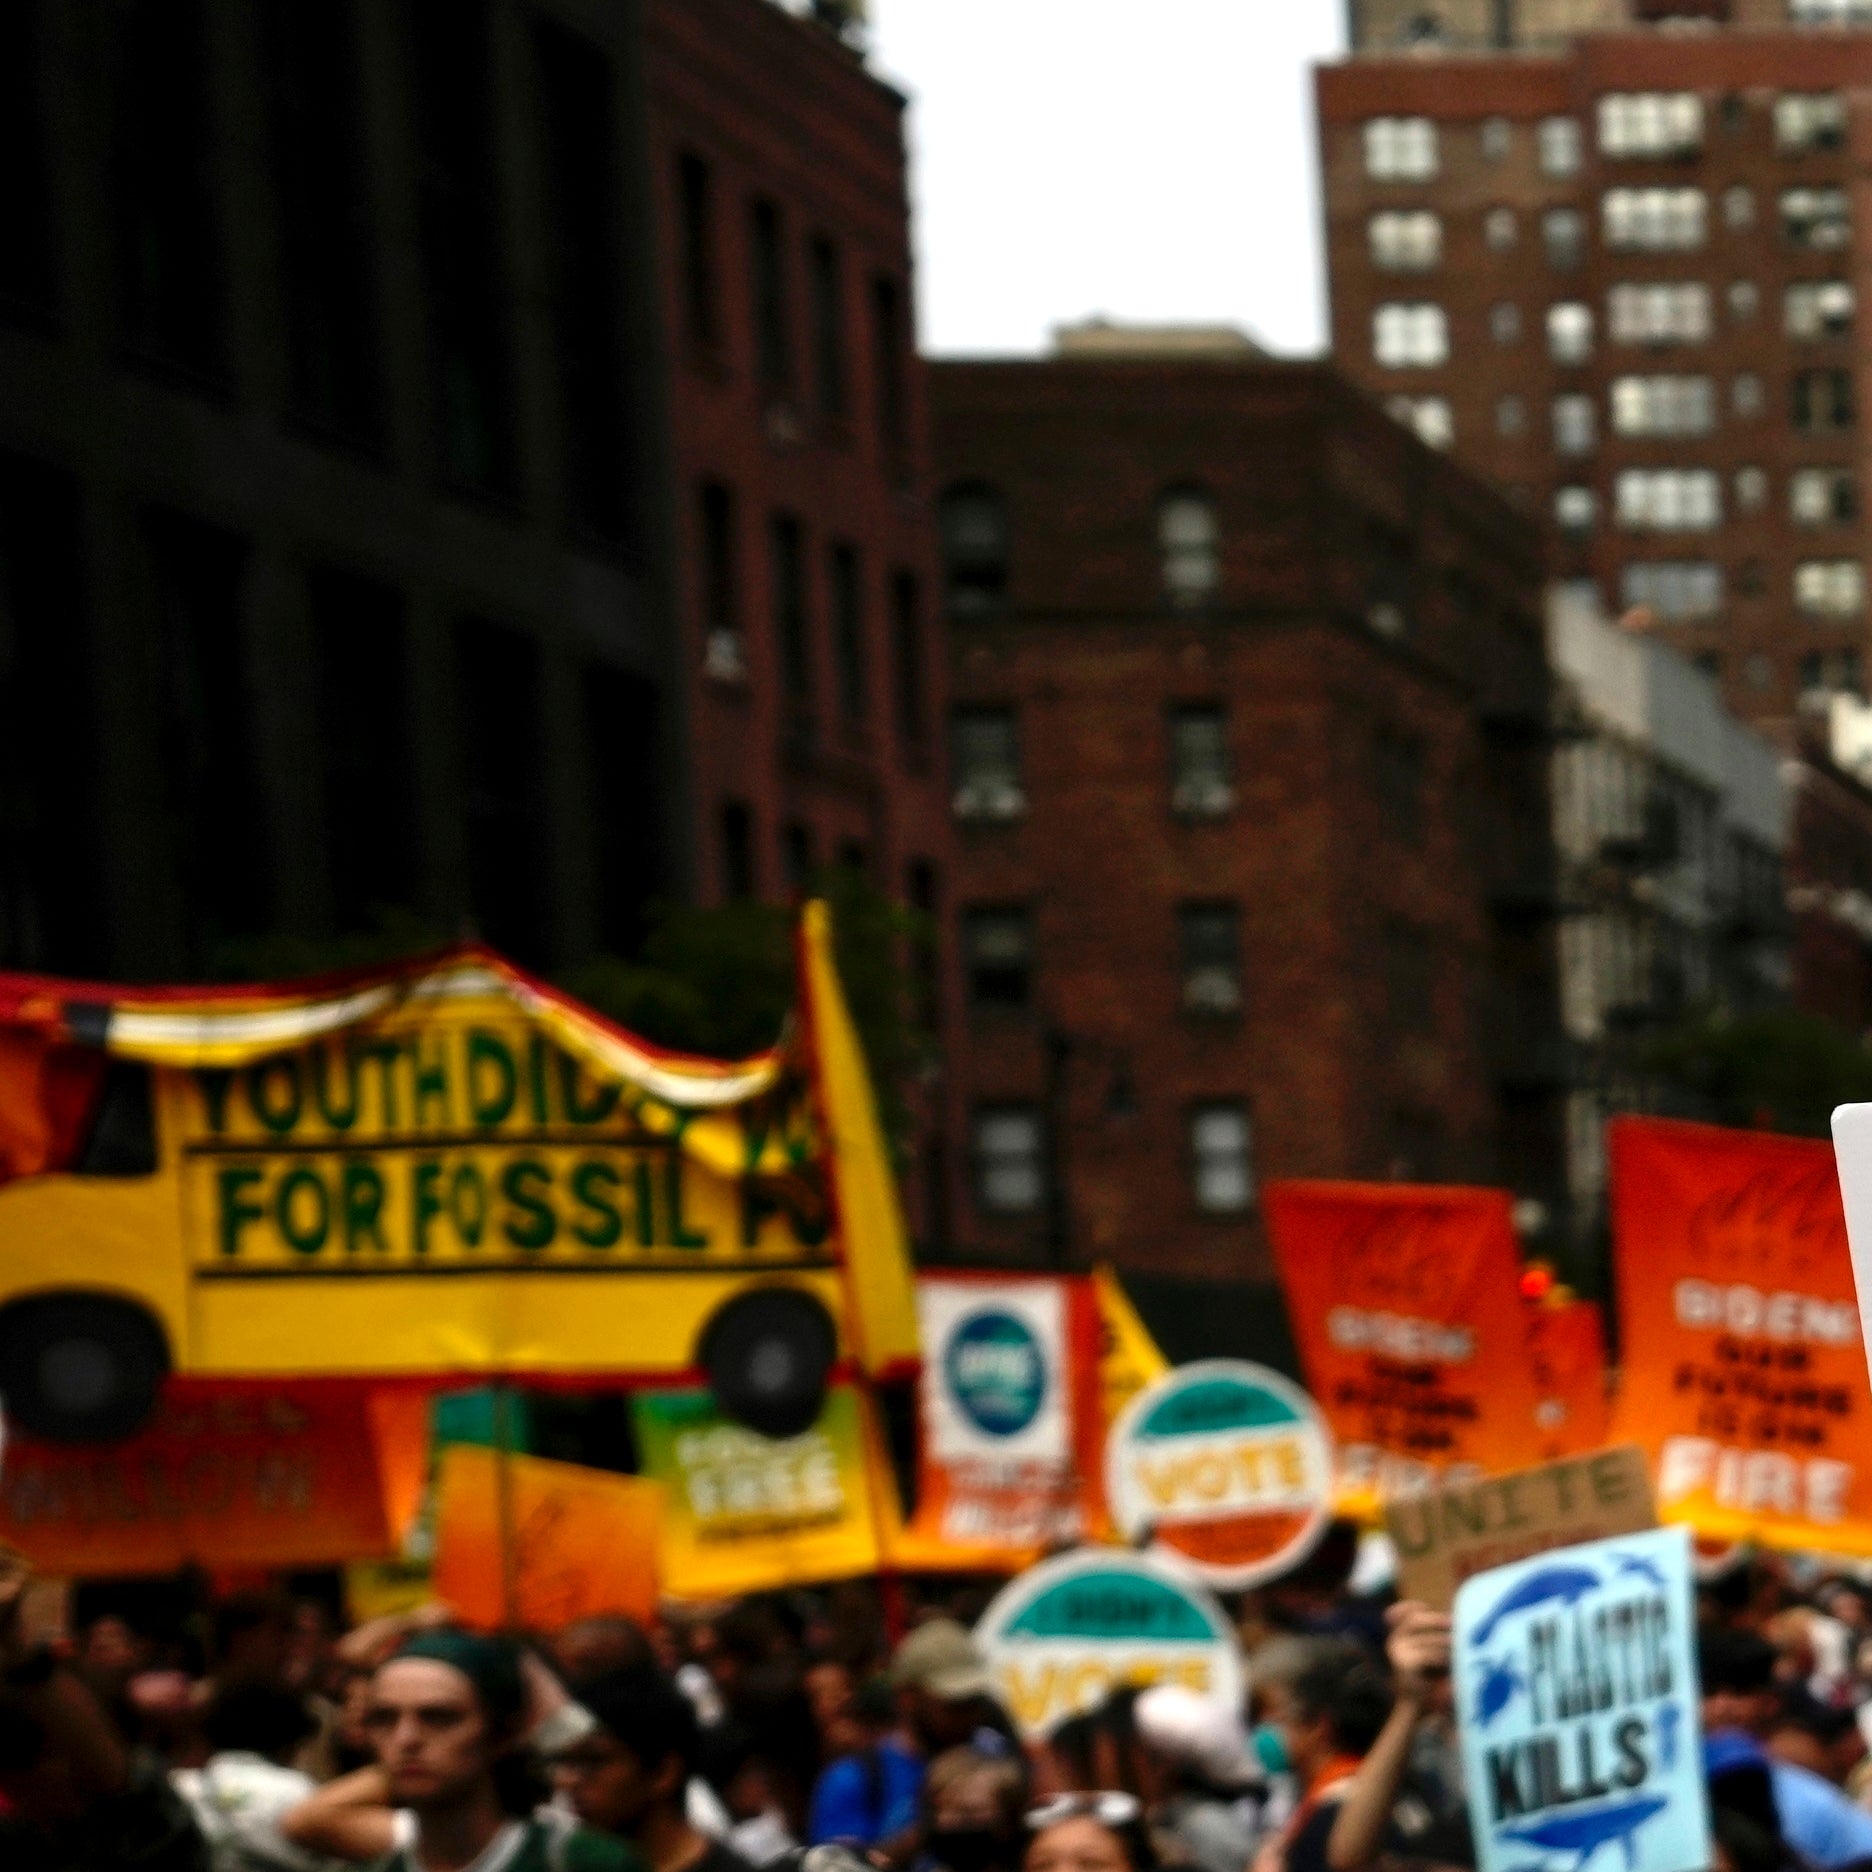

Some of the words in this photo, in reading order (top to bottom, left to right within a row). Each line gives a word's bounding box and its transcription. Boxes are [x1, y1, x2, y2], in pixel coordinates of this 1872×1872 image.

[196, 1033, 452, 1133] YOUTH
[217, 1164, 389, 1256] FOR
[412, 1159, 708, 1251] FOSSIL
[1136, 1436, 1304, 1505] VOTE
[1385, 1455, 1630, 1556] UNITE
[1659, 1434, 1856, 1524] FIRE
[1484, 1713, 1650, 1823] KILLS
